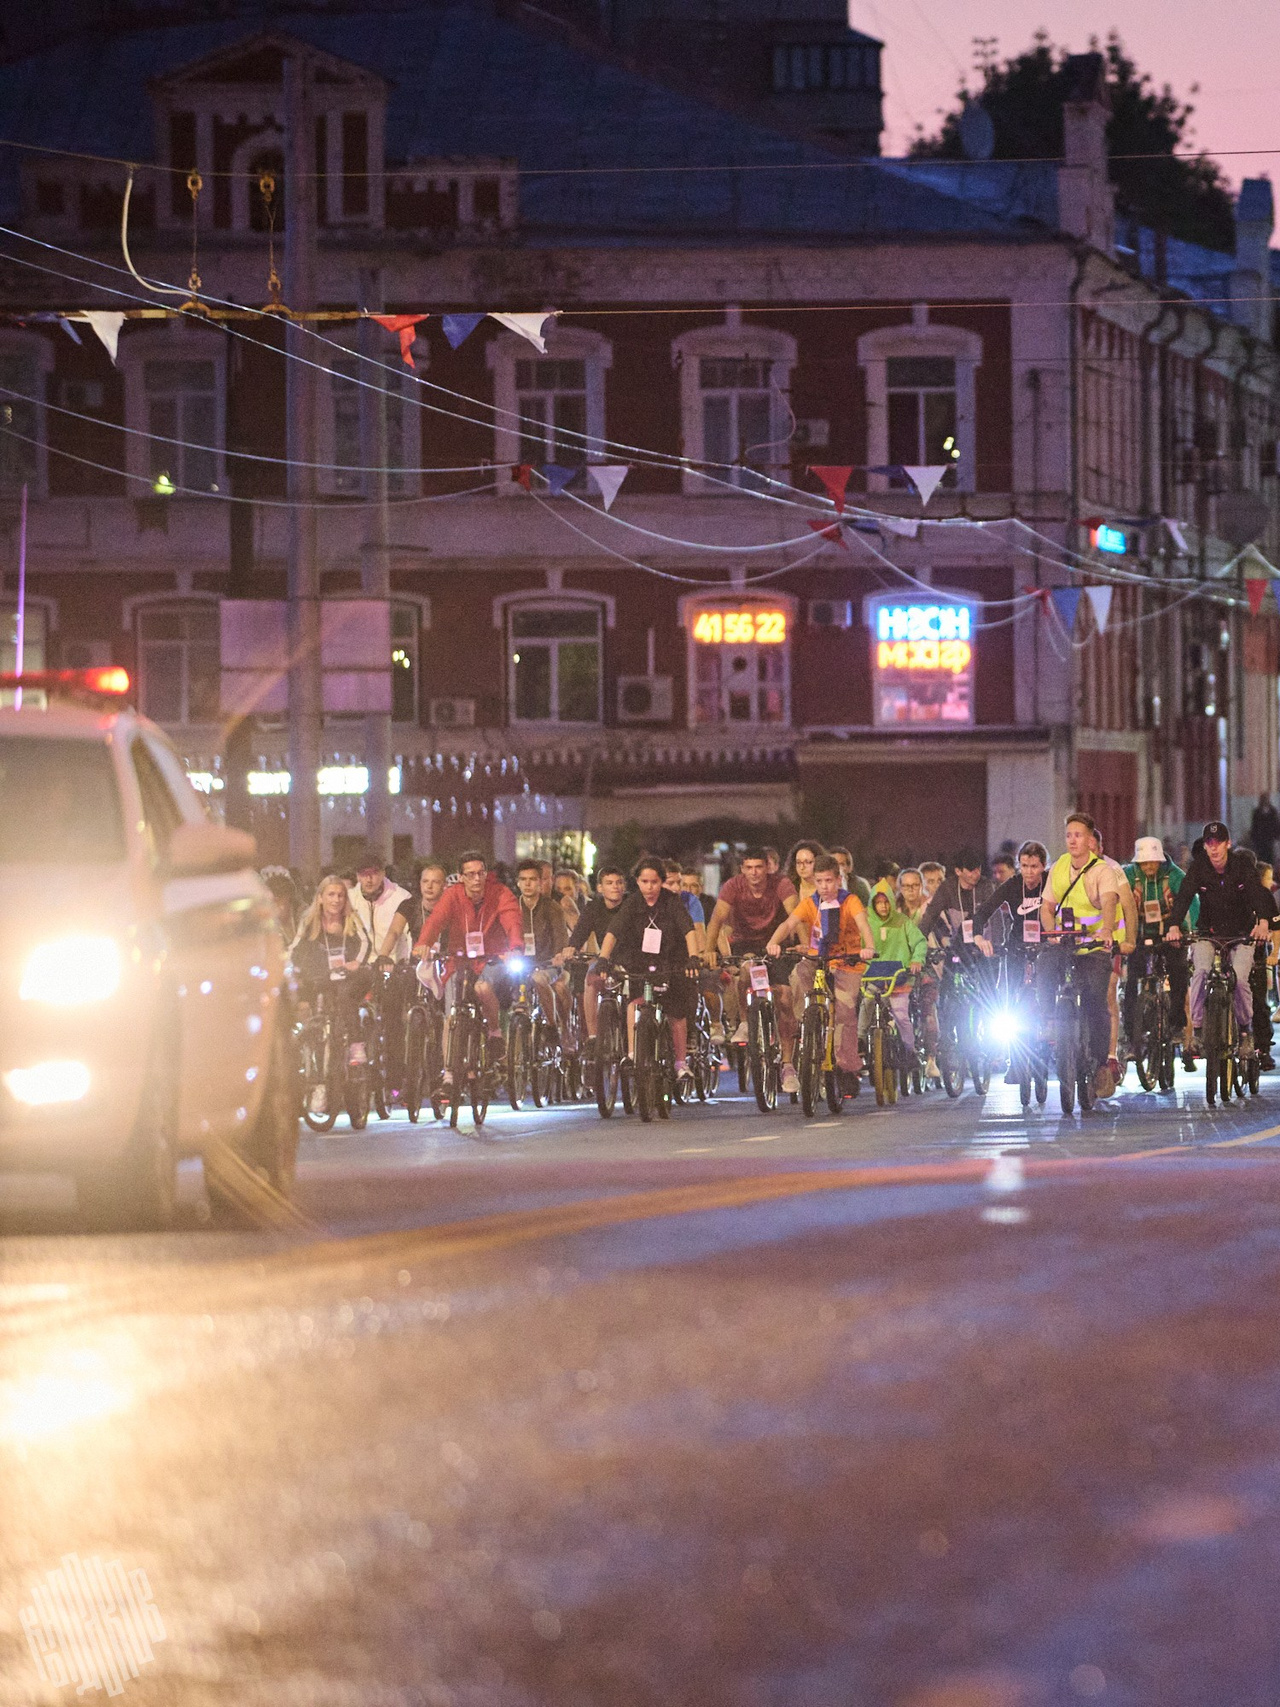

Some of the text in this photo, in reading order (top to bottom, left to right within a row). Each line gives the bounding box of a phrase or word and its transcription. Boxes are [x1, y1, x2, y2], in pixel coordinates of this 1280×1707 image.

[694, 612, 786, 643] 41 56 22
